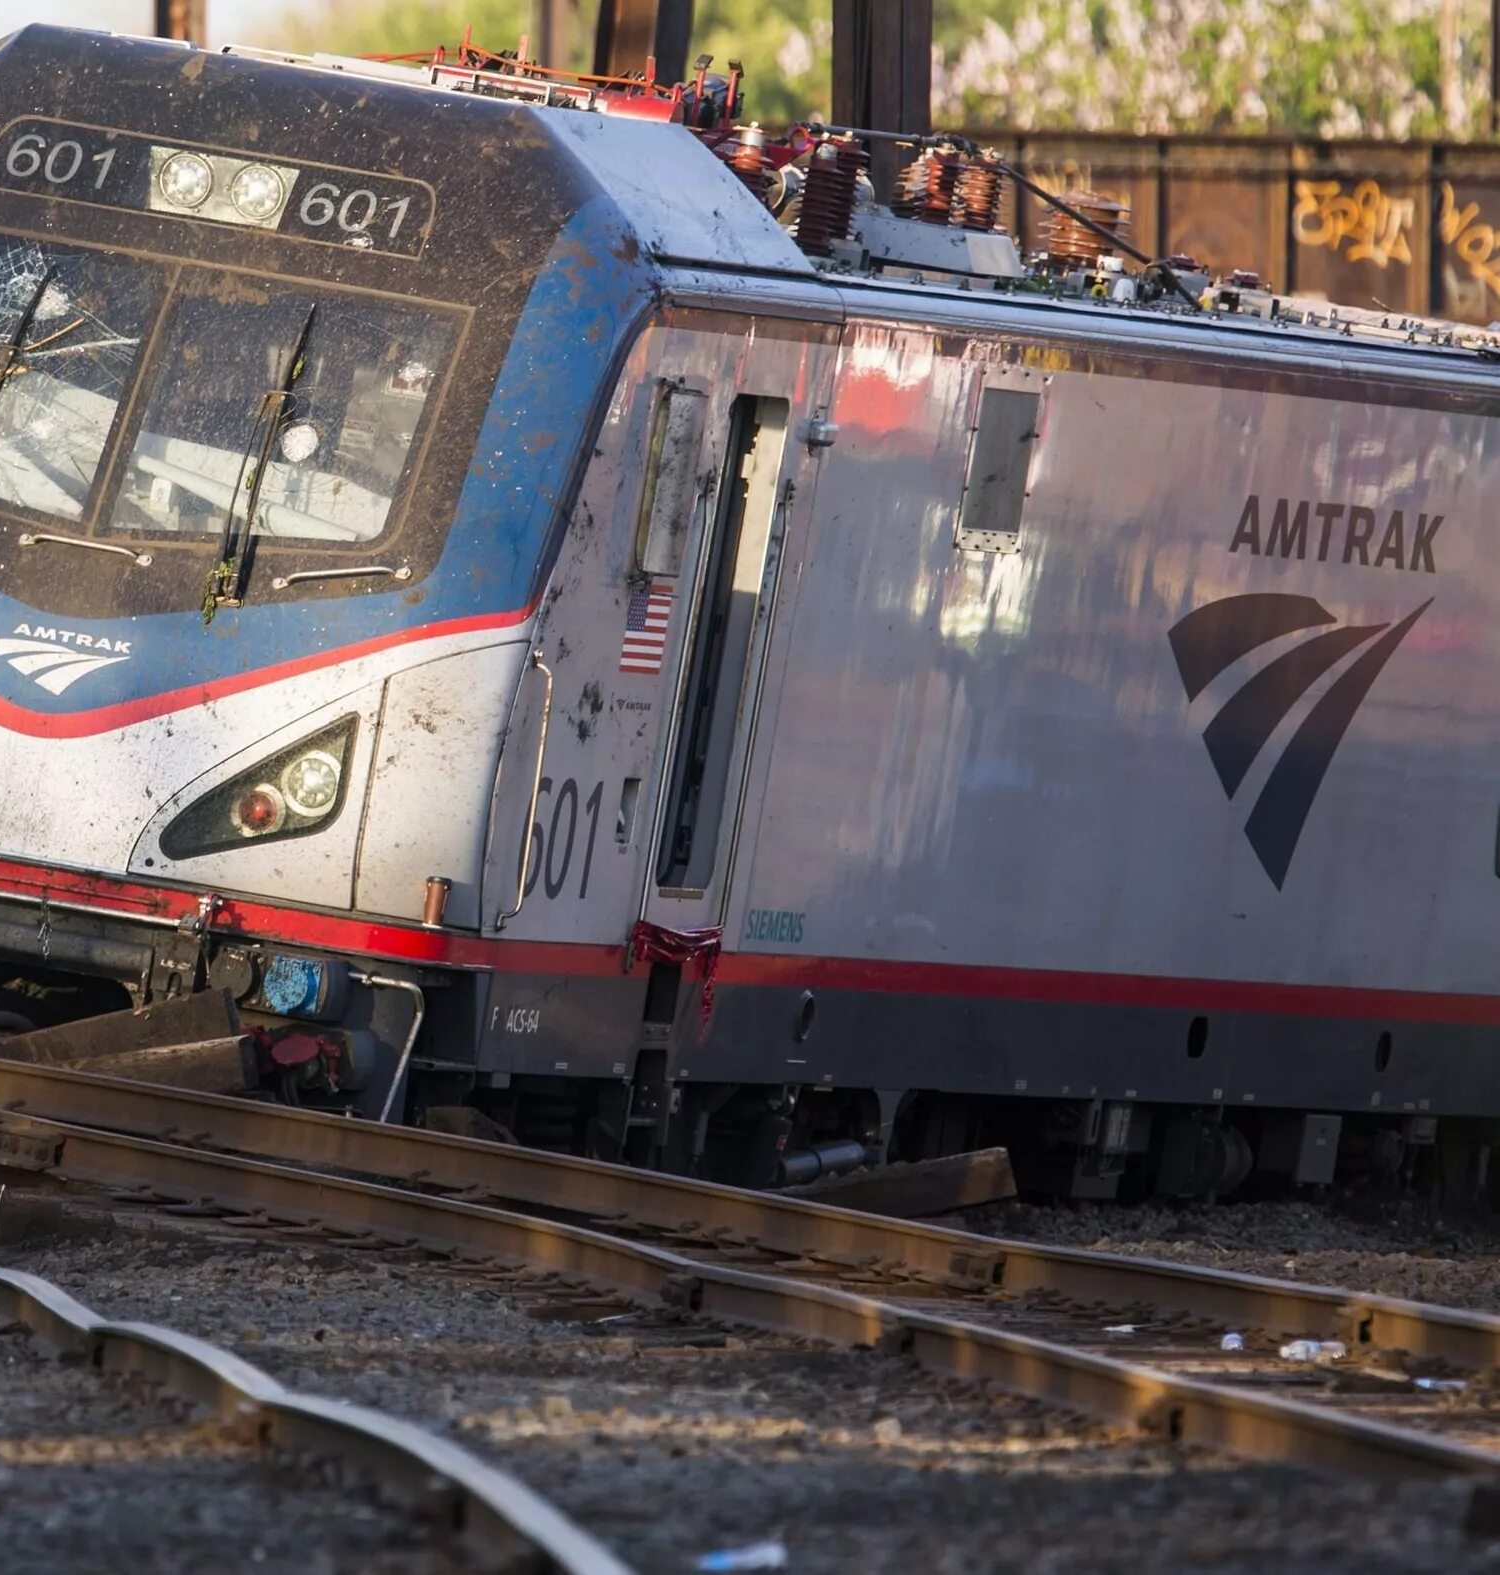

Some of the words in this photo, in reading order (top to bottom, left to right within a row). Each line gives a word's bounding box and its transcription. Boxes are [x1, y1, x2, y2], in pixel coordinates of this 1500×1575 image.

[6, 134, 117, 190] 601
[300, 183, 412, 239] 601
[1228, 494, 1445, 574] AMTRAK
[13, 623, 132, 654] AMTRAK
[517, 776, 604, 899] 601
[745, 908, 806, 944] SIEMENS
[490, 1006, 500, 1031] F
[506, 1008, 540, 1033] ACS-64
